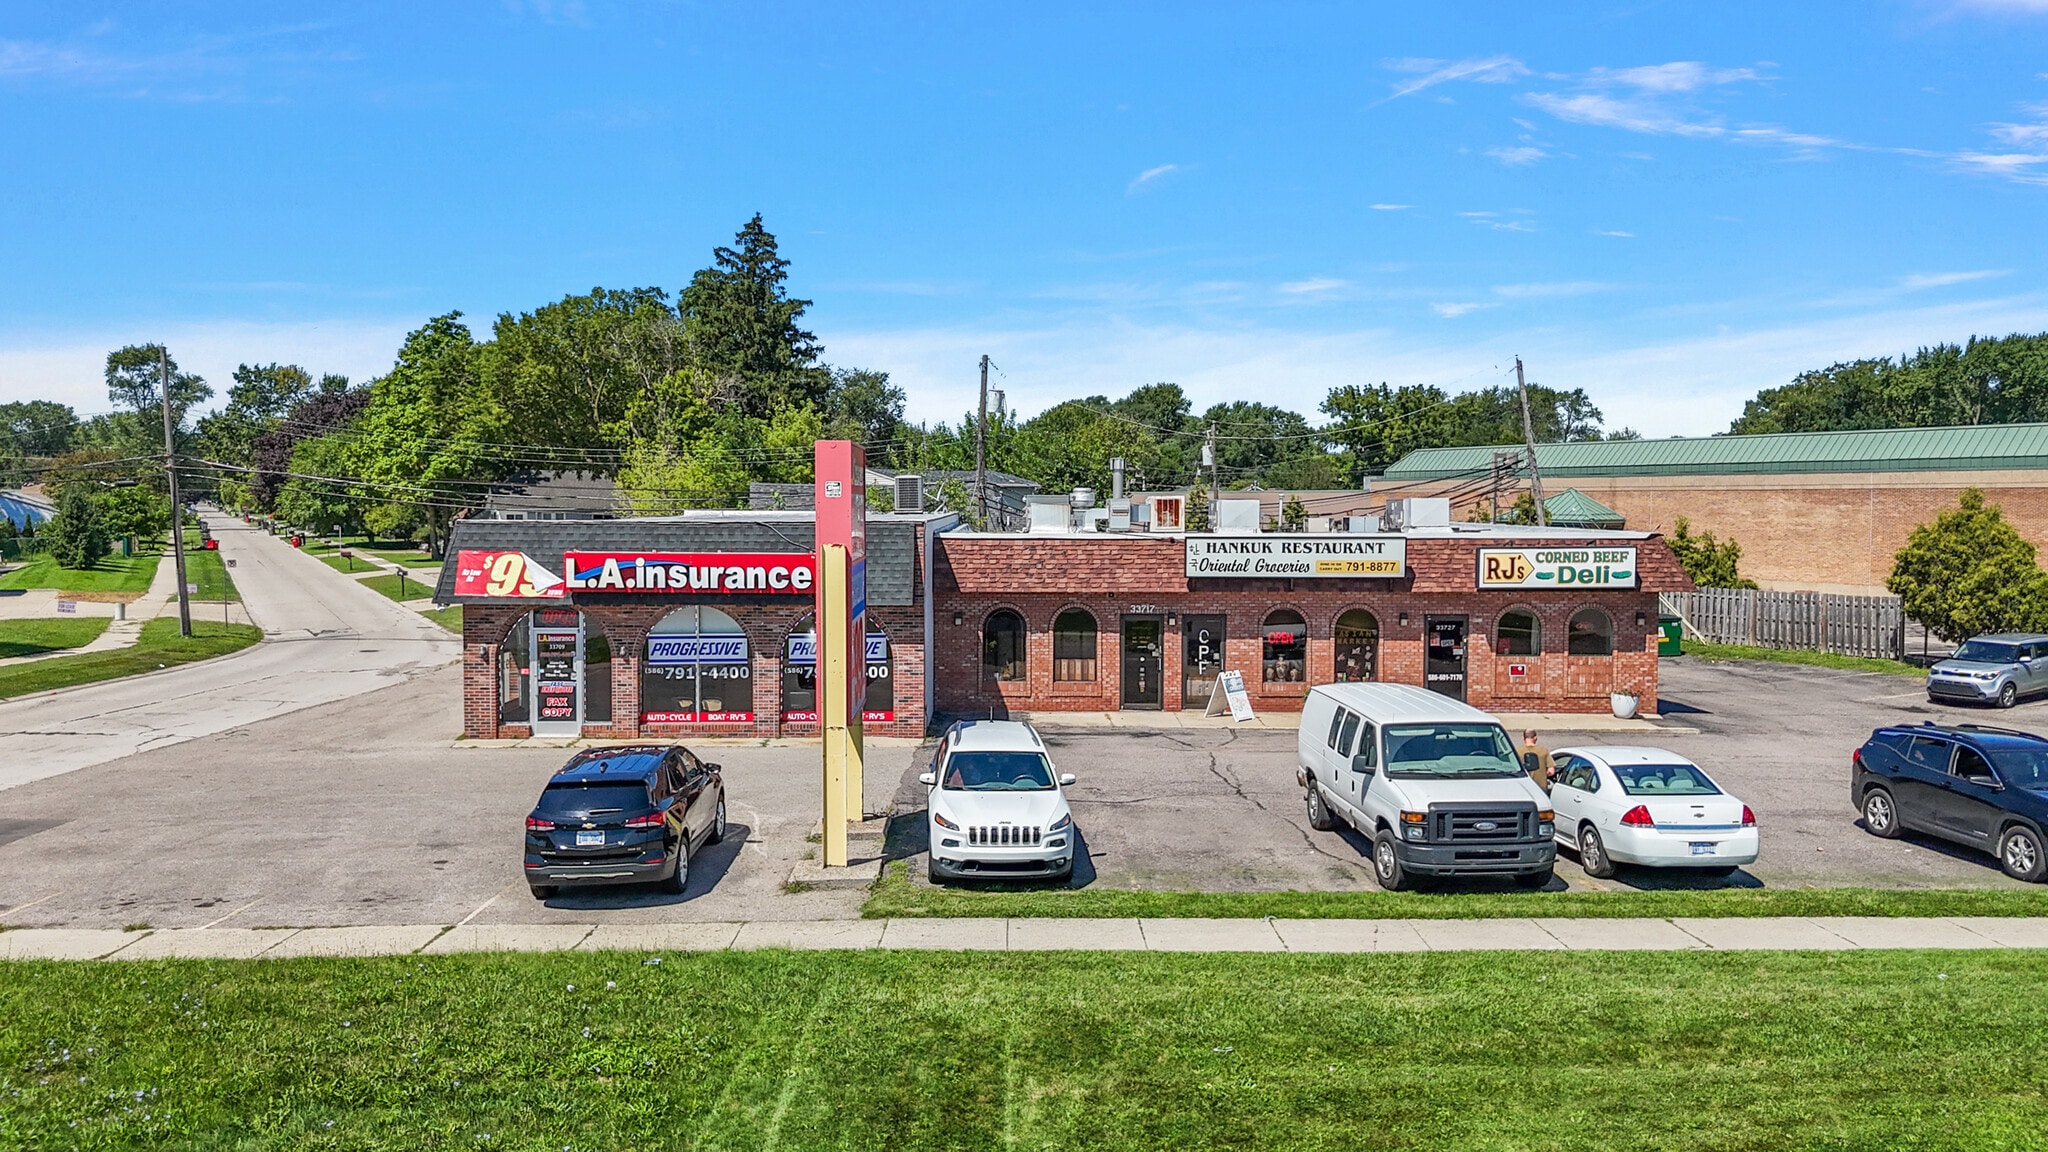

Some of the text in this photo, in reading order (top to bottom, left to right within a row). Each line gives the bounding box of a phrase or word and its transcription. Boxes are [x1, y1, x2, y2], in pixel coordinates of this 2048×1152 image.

[1206, 542, 1386, 554] HANKUK RESTAURANT
[1535, 551, 1629, 563] CORNED BEEF
[1199, 557, 1310, 572] Oriental Groceries
[1346, 561, 1396, 572] 791-8877
[1486, 555, 1525, 580] RJ's
[565, 557, 812, 589] L.A.insurance
[1557, 565, 1610, 584] Deli
[1130, 605, 1155, 613] 33717
[1268, 631, 1294, 644] OPEN
[651, 642, 743, 656] PROGRESSIVE
[546, 697, 568, 706] FAX
[542, 707, 573, 717] COPY
